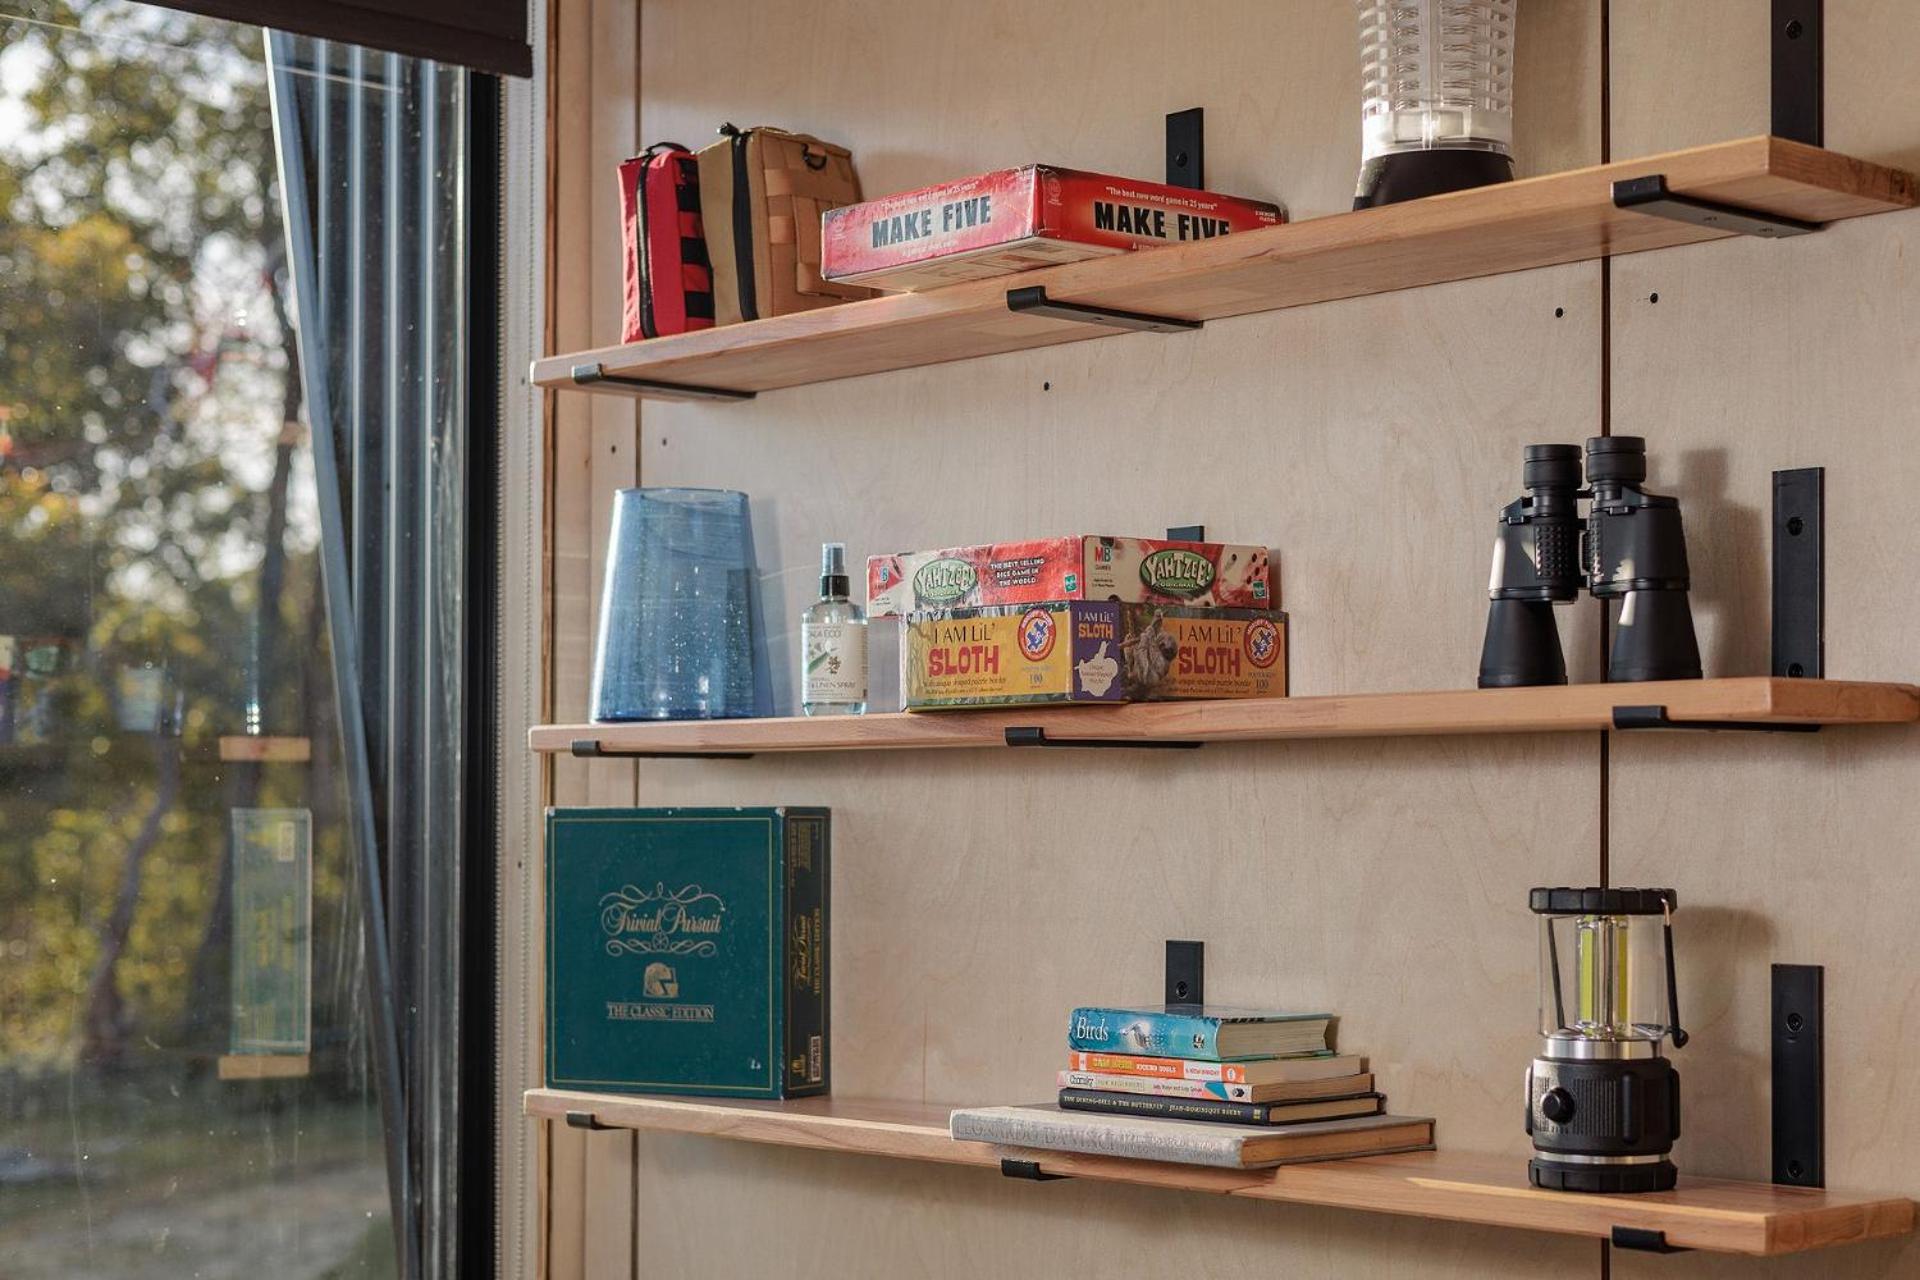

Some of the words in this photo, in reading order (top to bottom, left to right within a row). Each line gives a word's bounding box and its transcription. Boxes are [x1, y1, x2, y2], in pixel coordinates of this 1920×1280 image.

[873, 209, 932, 249] MAKE
[943, 195, 991, 232] FIVE
[1094, 201, 1167, 239] MAKE
[1095, 546, 1111, 562] MB
[916, 561, 975, 591] YAHTZEE!
[1144, 552, 1213, 586] YAHTZEE!
[1083, 611, 1098, 623] AM
[934, 628, 938, 644] I
[943, 625, 966, 644] AM
[1079, 622, 1114, 641] SLOTH
[1179, 624, 1182, 641] I
[1187, 624, 1212, 643] AM
[929, 645, 1000, 678] SLOTH
[1178, 646, 1241, 678] SLOTH
[601, 902, 661, 935] Trivial
[660, 902, 721, 935] Pursuit
[608, 1004, 627, 1019] THE
[629, 1004, 668, 1020] CLASSIC
[671, 1005, 714, 1021] EDITION
[1077, 1016, 1109, 1041] Birds
